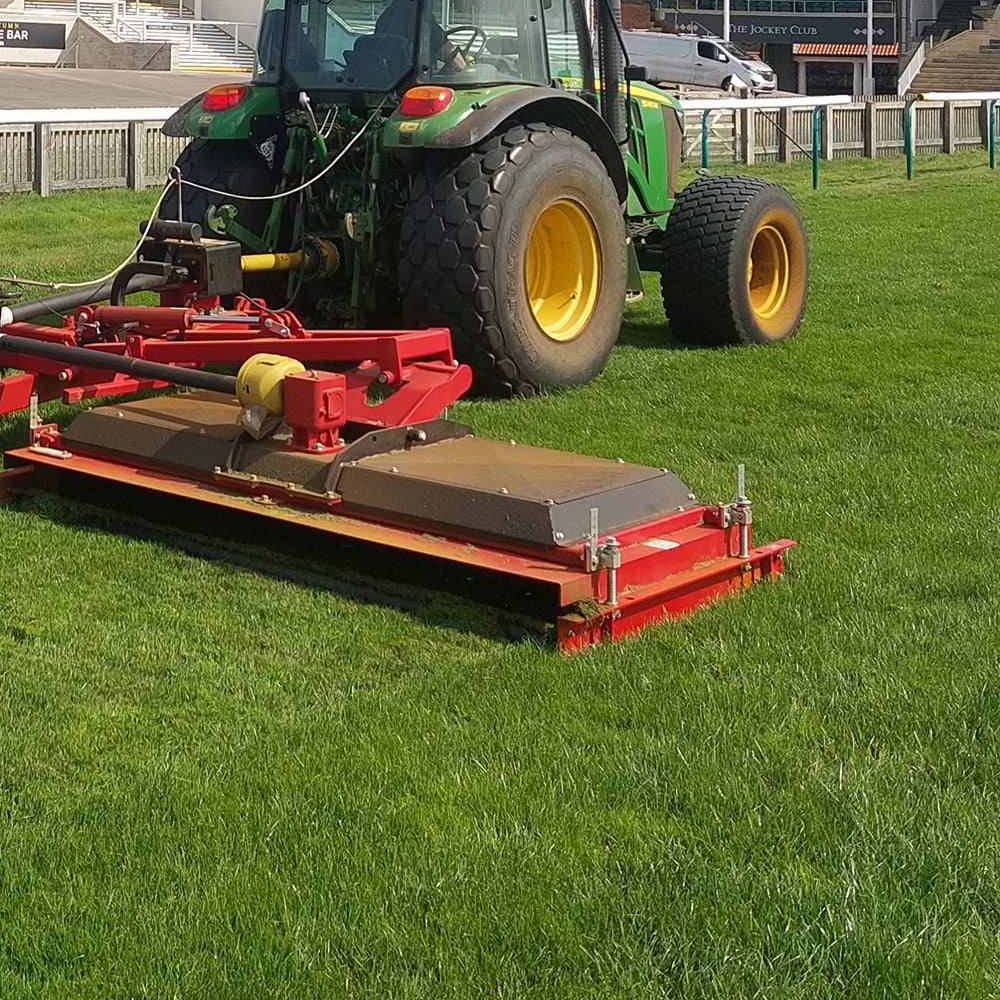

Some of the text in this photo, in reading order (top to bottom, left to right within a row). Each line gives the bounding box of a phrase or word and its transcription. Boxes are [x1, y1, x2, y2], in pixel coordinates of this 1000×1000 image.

[729, 24, 818, 35] THE JOCKEY CLUB
[6, 30, 29, 40] BAR
